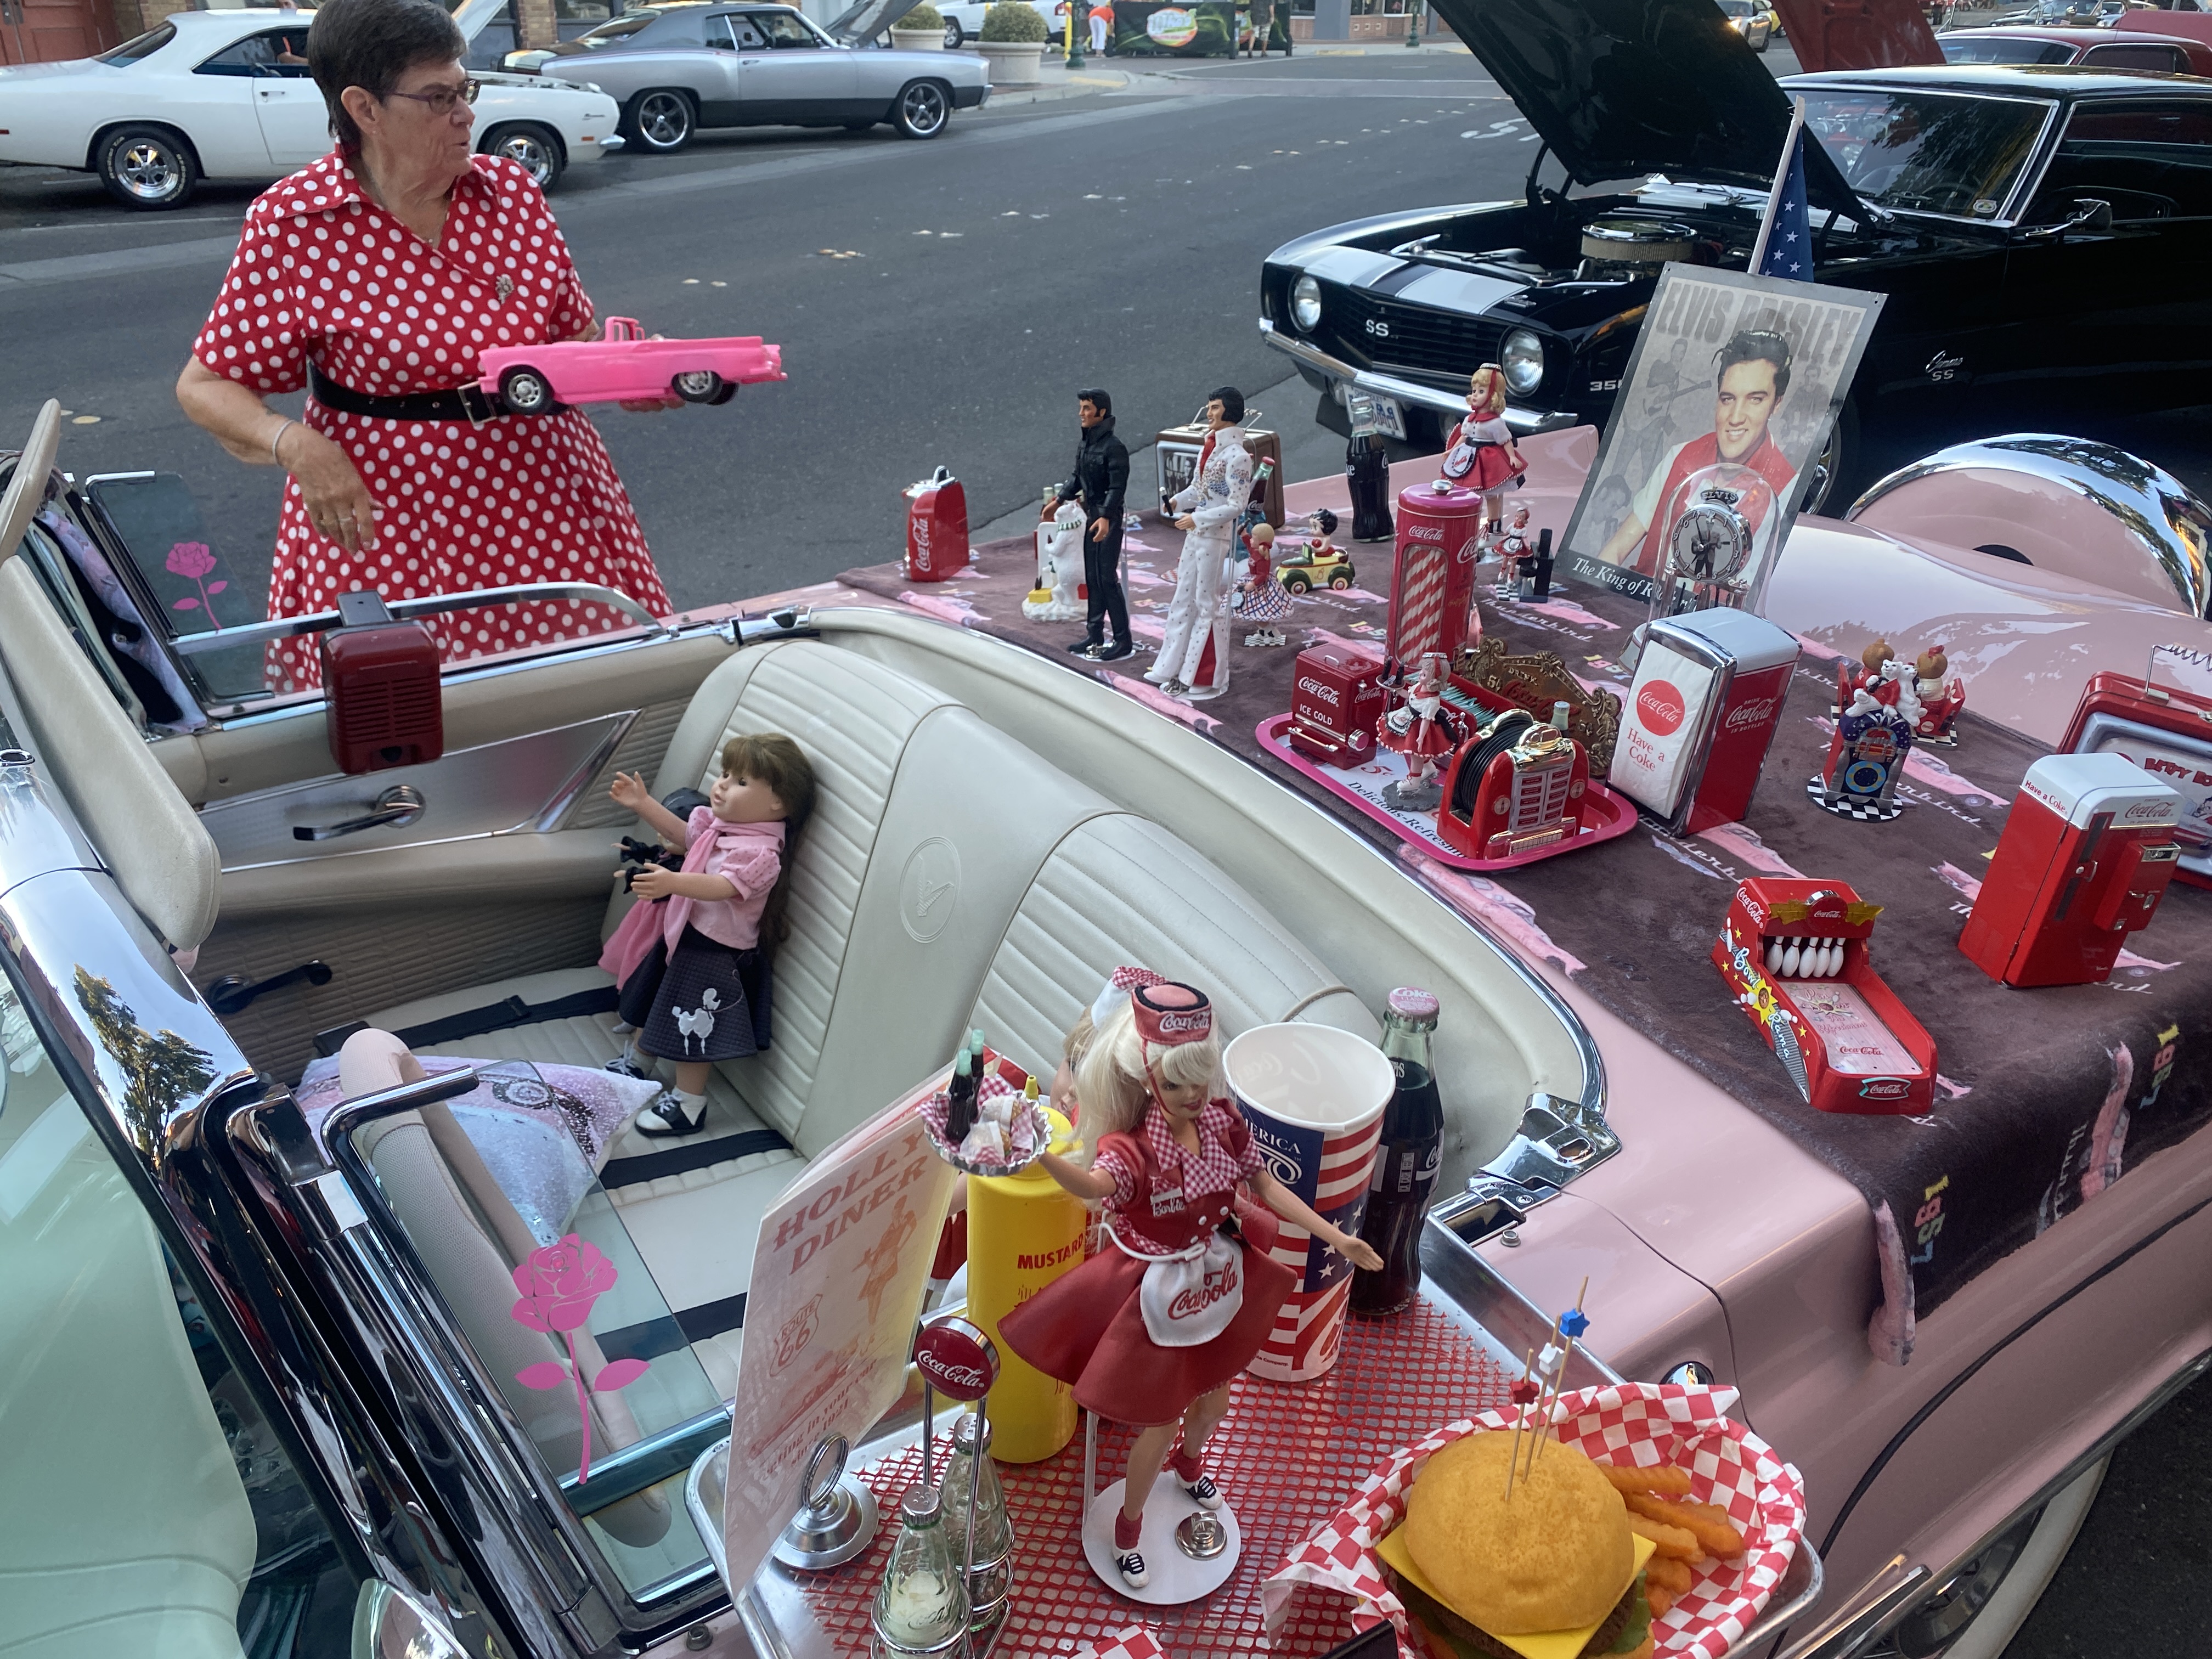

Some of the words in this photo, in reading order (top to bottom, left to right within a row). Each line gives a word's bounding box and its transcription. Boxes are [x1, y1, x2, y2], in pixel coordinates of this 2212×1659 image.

[1366, 319, 1389, 336] SS
[1656, 282, 1734, 343] ELVIS
[1932, 369, 1954, 381] SS
[1701, 491, 1737, 501] ELVIS
[912, 516, 932, 573] Coca-Cola
[1408, 525, 1444, 541] Coca-Cola
[1572, 557, 1595, 578] The
[1595, 567, 1626, 594] King
[1627, 579, 1645, 595] of
[1481, 599, 1593, 642] Thunderbird
[1298, 676, 1341, 706] Coca-Cola
[1508, 668, 1538, 686] DRINK
[1300, 703, 1312, 716] ICE
[1313, 710, 1333, 726] COLD
[1639, 692, 1682, 723] Coca-Cola
[1725, 697, 1778, 729] Coca-Cola
[1744, 697, 1760, 705] DRINK
[1740, 721, 1765, 732] BOTTLES
[1627, 727, 1654, 754] Have
[1658, 752, 1666, 763] a
[1629, 746, 1656, 772] Coke
[2145, 758, 2192, 779] BETTY
[2025, 780, 2042, 796] Have
[2049, 795, 2067, 813] Coke
[2125, 802, 2176, 819] Coca-Cola
[1736, 887, 1765, 927] Coca-Cola
[1814, 908, 1842, 919] Coca-Cola
[1733, 946, 1760, 989] Bowl
[1392, 987, 1433, 998] Coke
[1768, 1012, 1791, 1058] Rama
[1839, 1046, 1884, 1056] Coca-Cola
[1870, 1084, 1902, 1095] Coca-Cola
[1246, 1118, 1301, 1155] ERICA
[790, 1154, 928, 1276] DINER
[1153, 1198, 1186, 1217] Barbie
[1910, 1175, 1950, 1265] 1957
[1017, 1232, 1084, 1269] MUSTARD
[781, 1300, 818, 1340] ROUTE
[778, 1319, 810, 1367] 66
[918, 1350, 980, 1389] Coca-Cola
